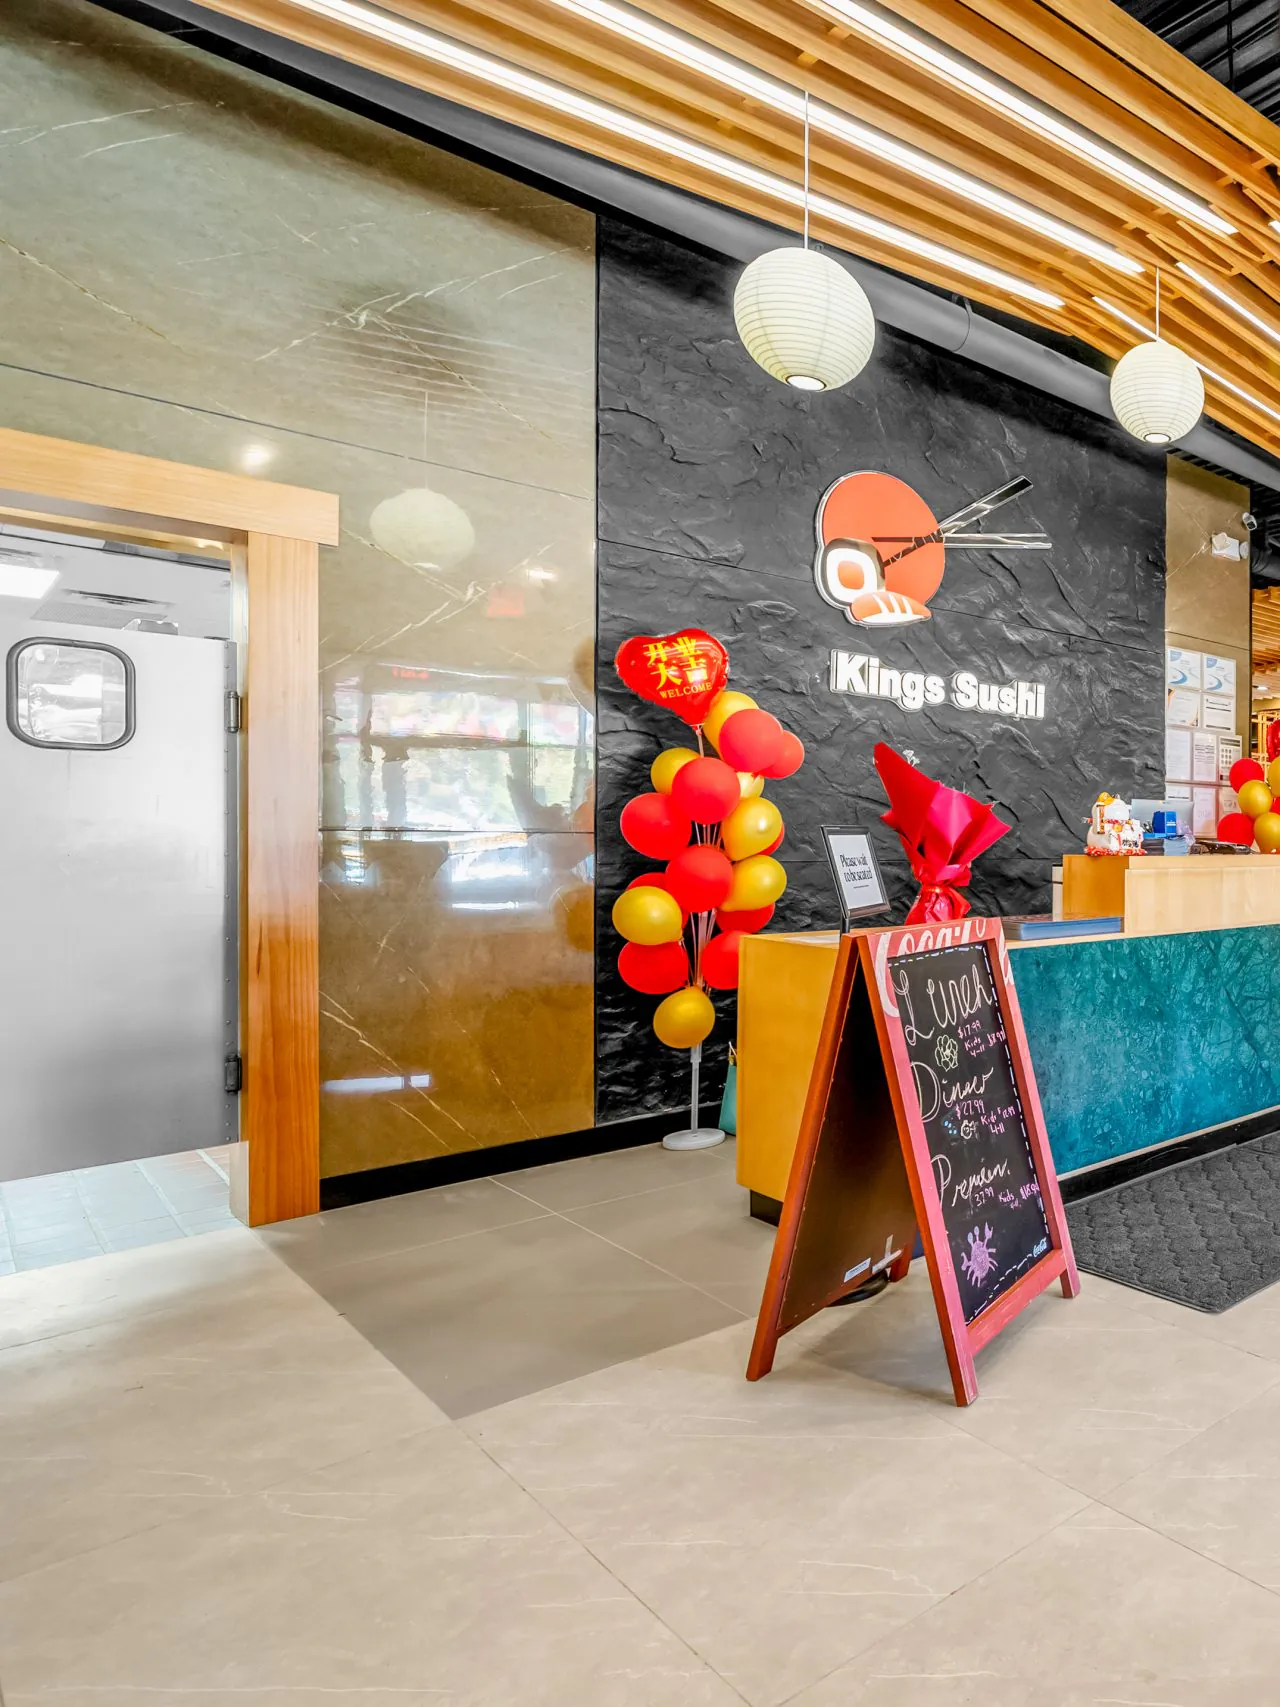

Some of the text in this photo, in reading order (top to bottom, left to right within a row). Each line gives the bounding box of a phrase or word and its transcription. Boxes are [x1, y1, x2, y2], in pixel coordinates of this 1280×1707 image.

[660, 682, 712, 699] WELCOME
[834, 651, 1045, 718] Kings Sushi
[840, 854, 857, 867] Please
[892, 964, 993, 1046] Lunch
[964, 1036, 982, 1051] Kids
[911, 1061, 994, 1123] Dinner
